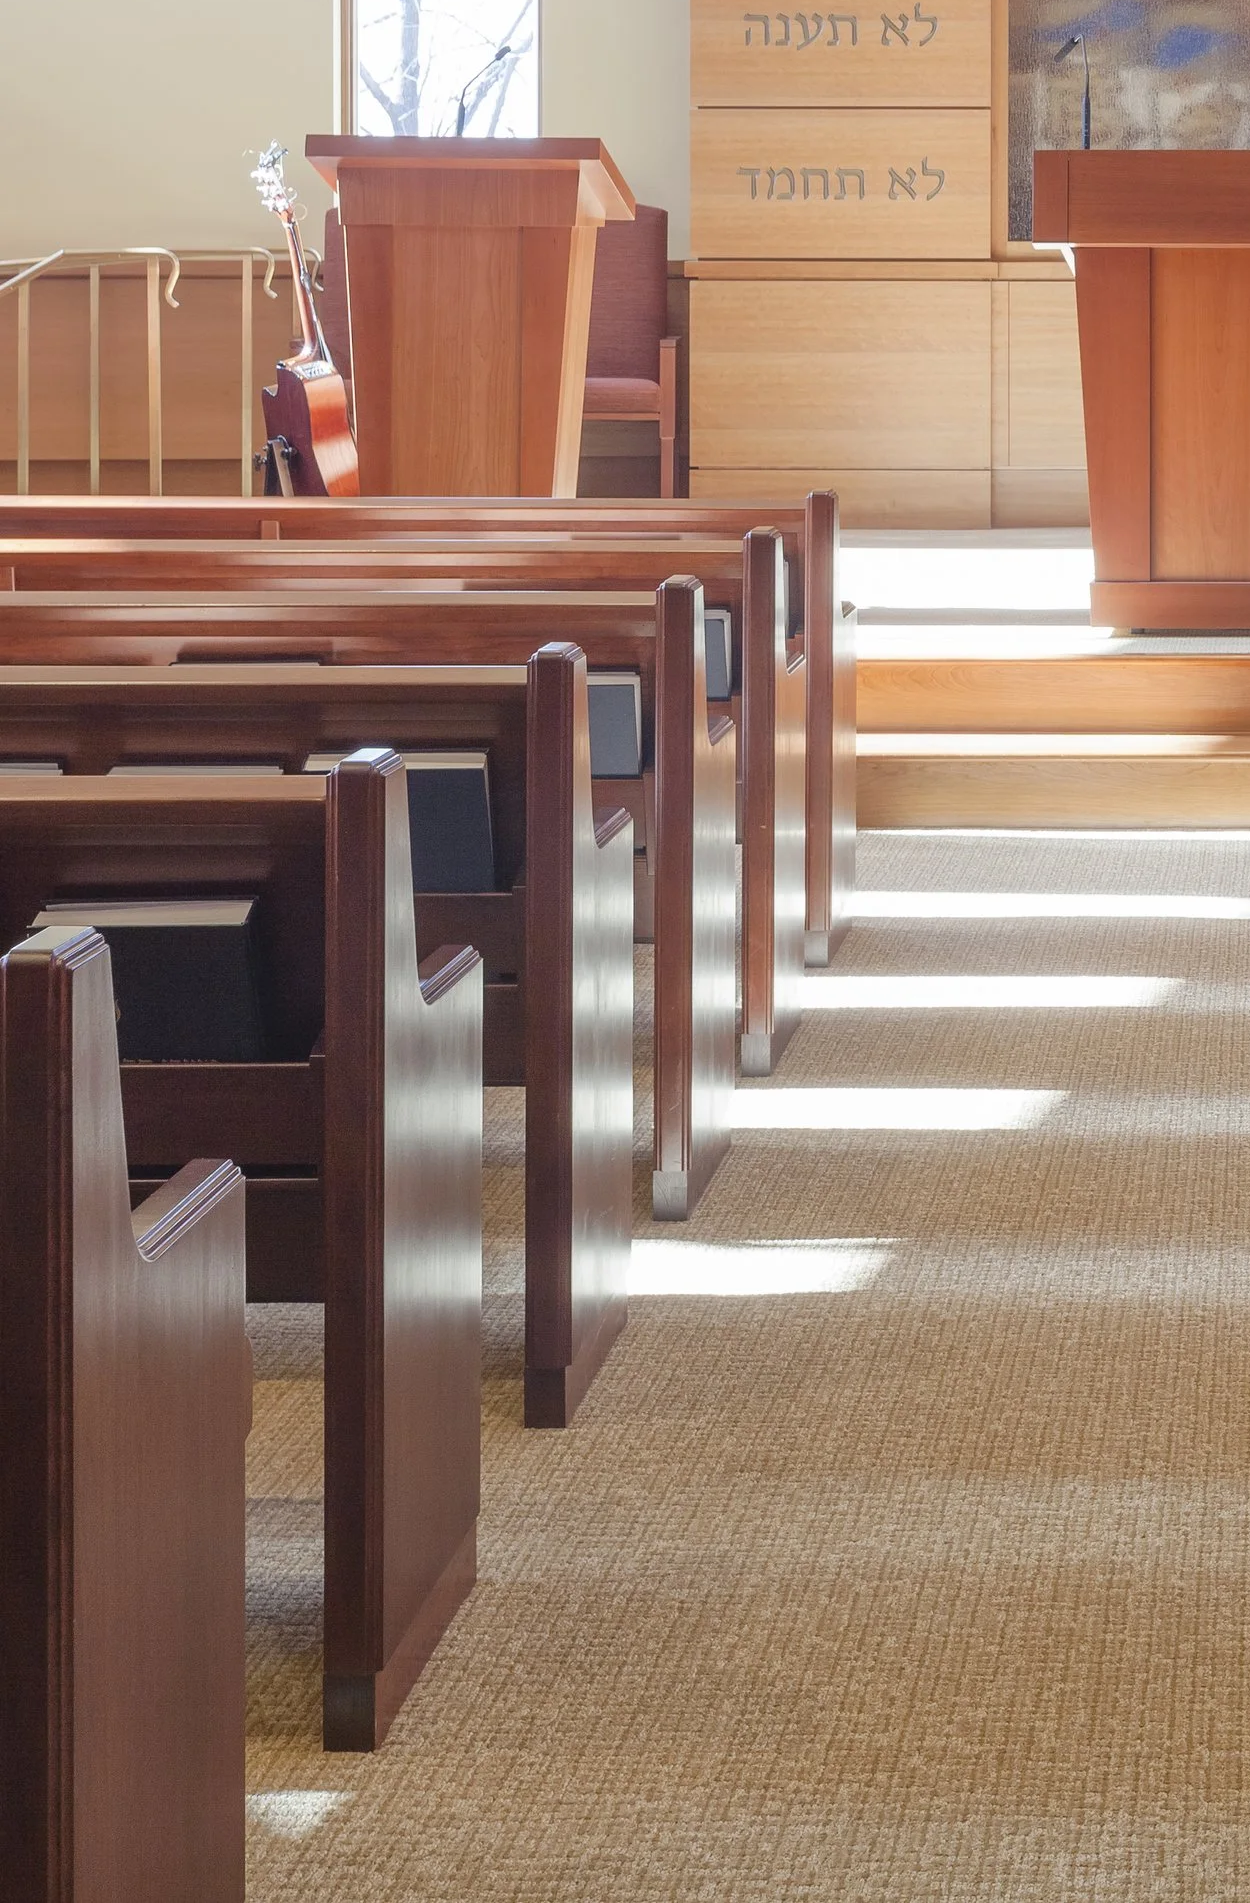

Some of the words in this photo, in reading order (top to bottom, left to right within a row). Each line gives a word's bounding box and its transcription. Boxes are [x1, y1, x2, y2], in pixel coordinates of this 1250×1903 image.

[742, 10, 860, 51] תענה
[880, 2, 941, 48] לא
[736, 165, 867, 203] תחמד
[887, 158, 946, 203] לא
